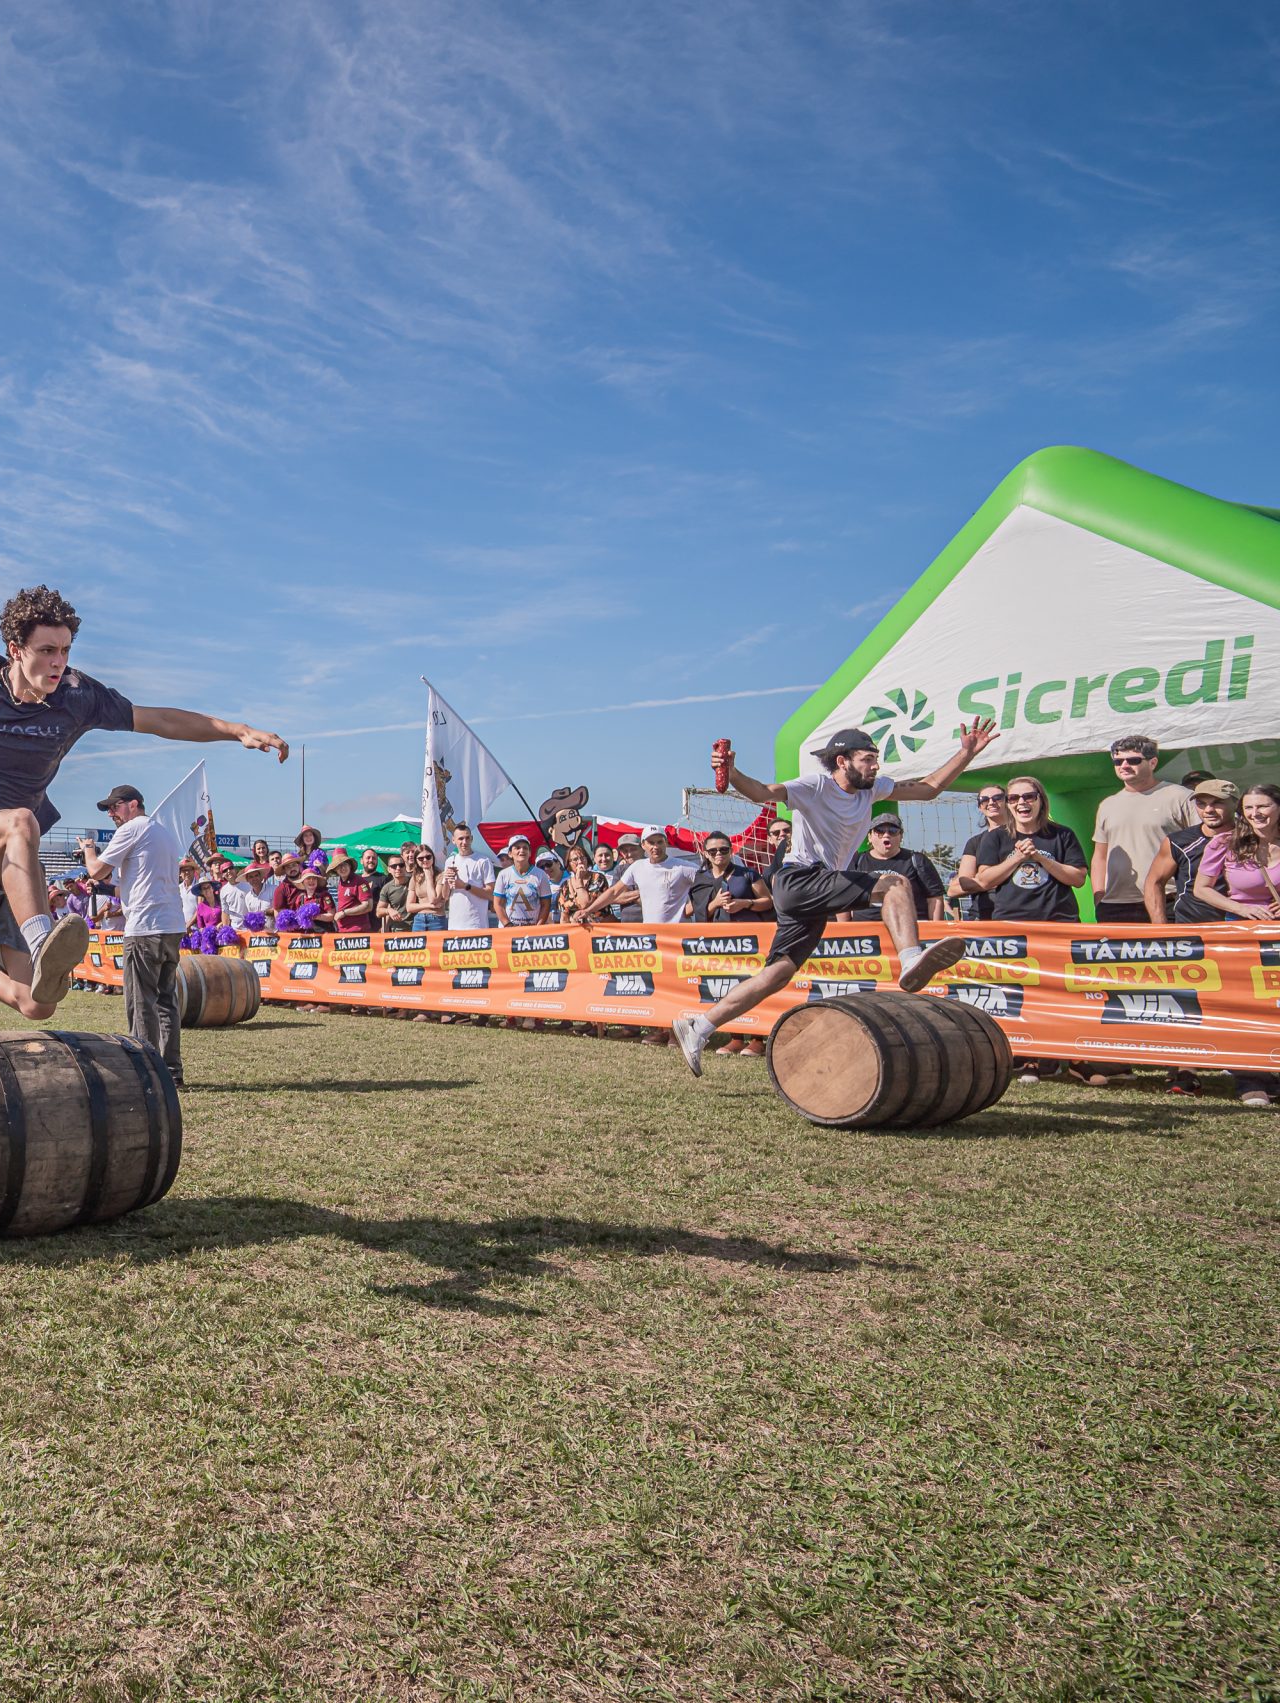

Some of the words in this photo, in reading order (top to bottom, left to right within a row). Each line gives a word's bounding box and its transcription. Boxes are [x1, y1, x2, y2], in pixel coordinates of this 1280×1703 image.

[952, 634, 1255, 740] Sicredi
[218, 837, 235, 845] 2022
[301, 938, 320, 948] MAIS
[336, 937, 347, 949] TÁ
[347, 938, 368, 949] MAIS
[387, 937, 399, 950] TÁ
[399, 938, 424, 950] MAIS
[447, 936, 459, 951] TÁ
[461, 937, 489, 950] MAIS
[515, 935, 531, 951] TÁ
[533, 937, 565, 951] MAIS
[596, 935, 613, 951] TÁ
[615, 937, 652, 951] MAIS
[687, 936, 708, 953] TÁ
[711, 938, 753, 953] MAIS
[823, 939, 874, 955] MAIS
[964, 939, 1019, 957] MAIS
[1080, 937, 1116, 961] TÁ
[1120, 940, 1194, 960] MAIS
[288, 949, 319, 960] BARATO
[331, 951, 370, 962] BARATO
[383, 951, 427, 965] BARATO
[442, 952, 493, 966] BARATO
[511, 953, 571, 968] BARATO
[593, 954, 657, 969] BARATO
[681, 956, 762, 972] BARATO
[800, 959, 883, 976] ARATO
[940, 961, 1030, 981] ARATO
[1073, 964, 1208, 985] BARATO
[795, 981, 809, 989] NO
[928, 986, 945, 994] NO
[1085, 992, 1104, 1000] NO
[1082, 1040, 1111, 1048] TUDO
[1149, 1044, 1208, 1055] ECONOMIA
